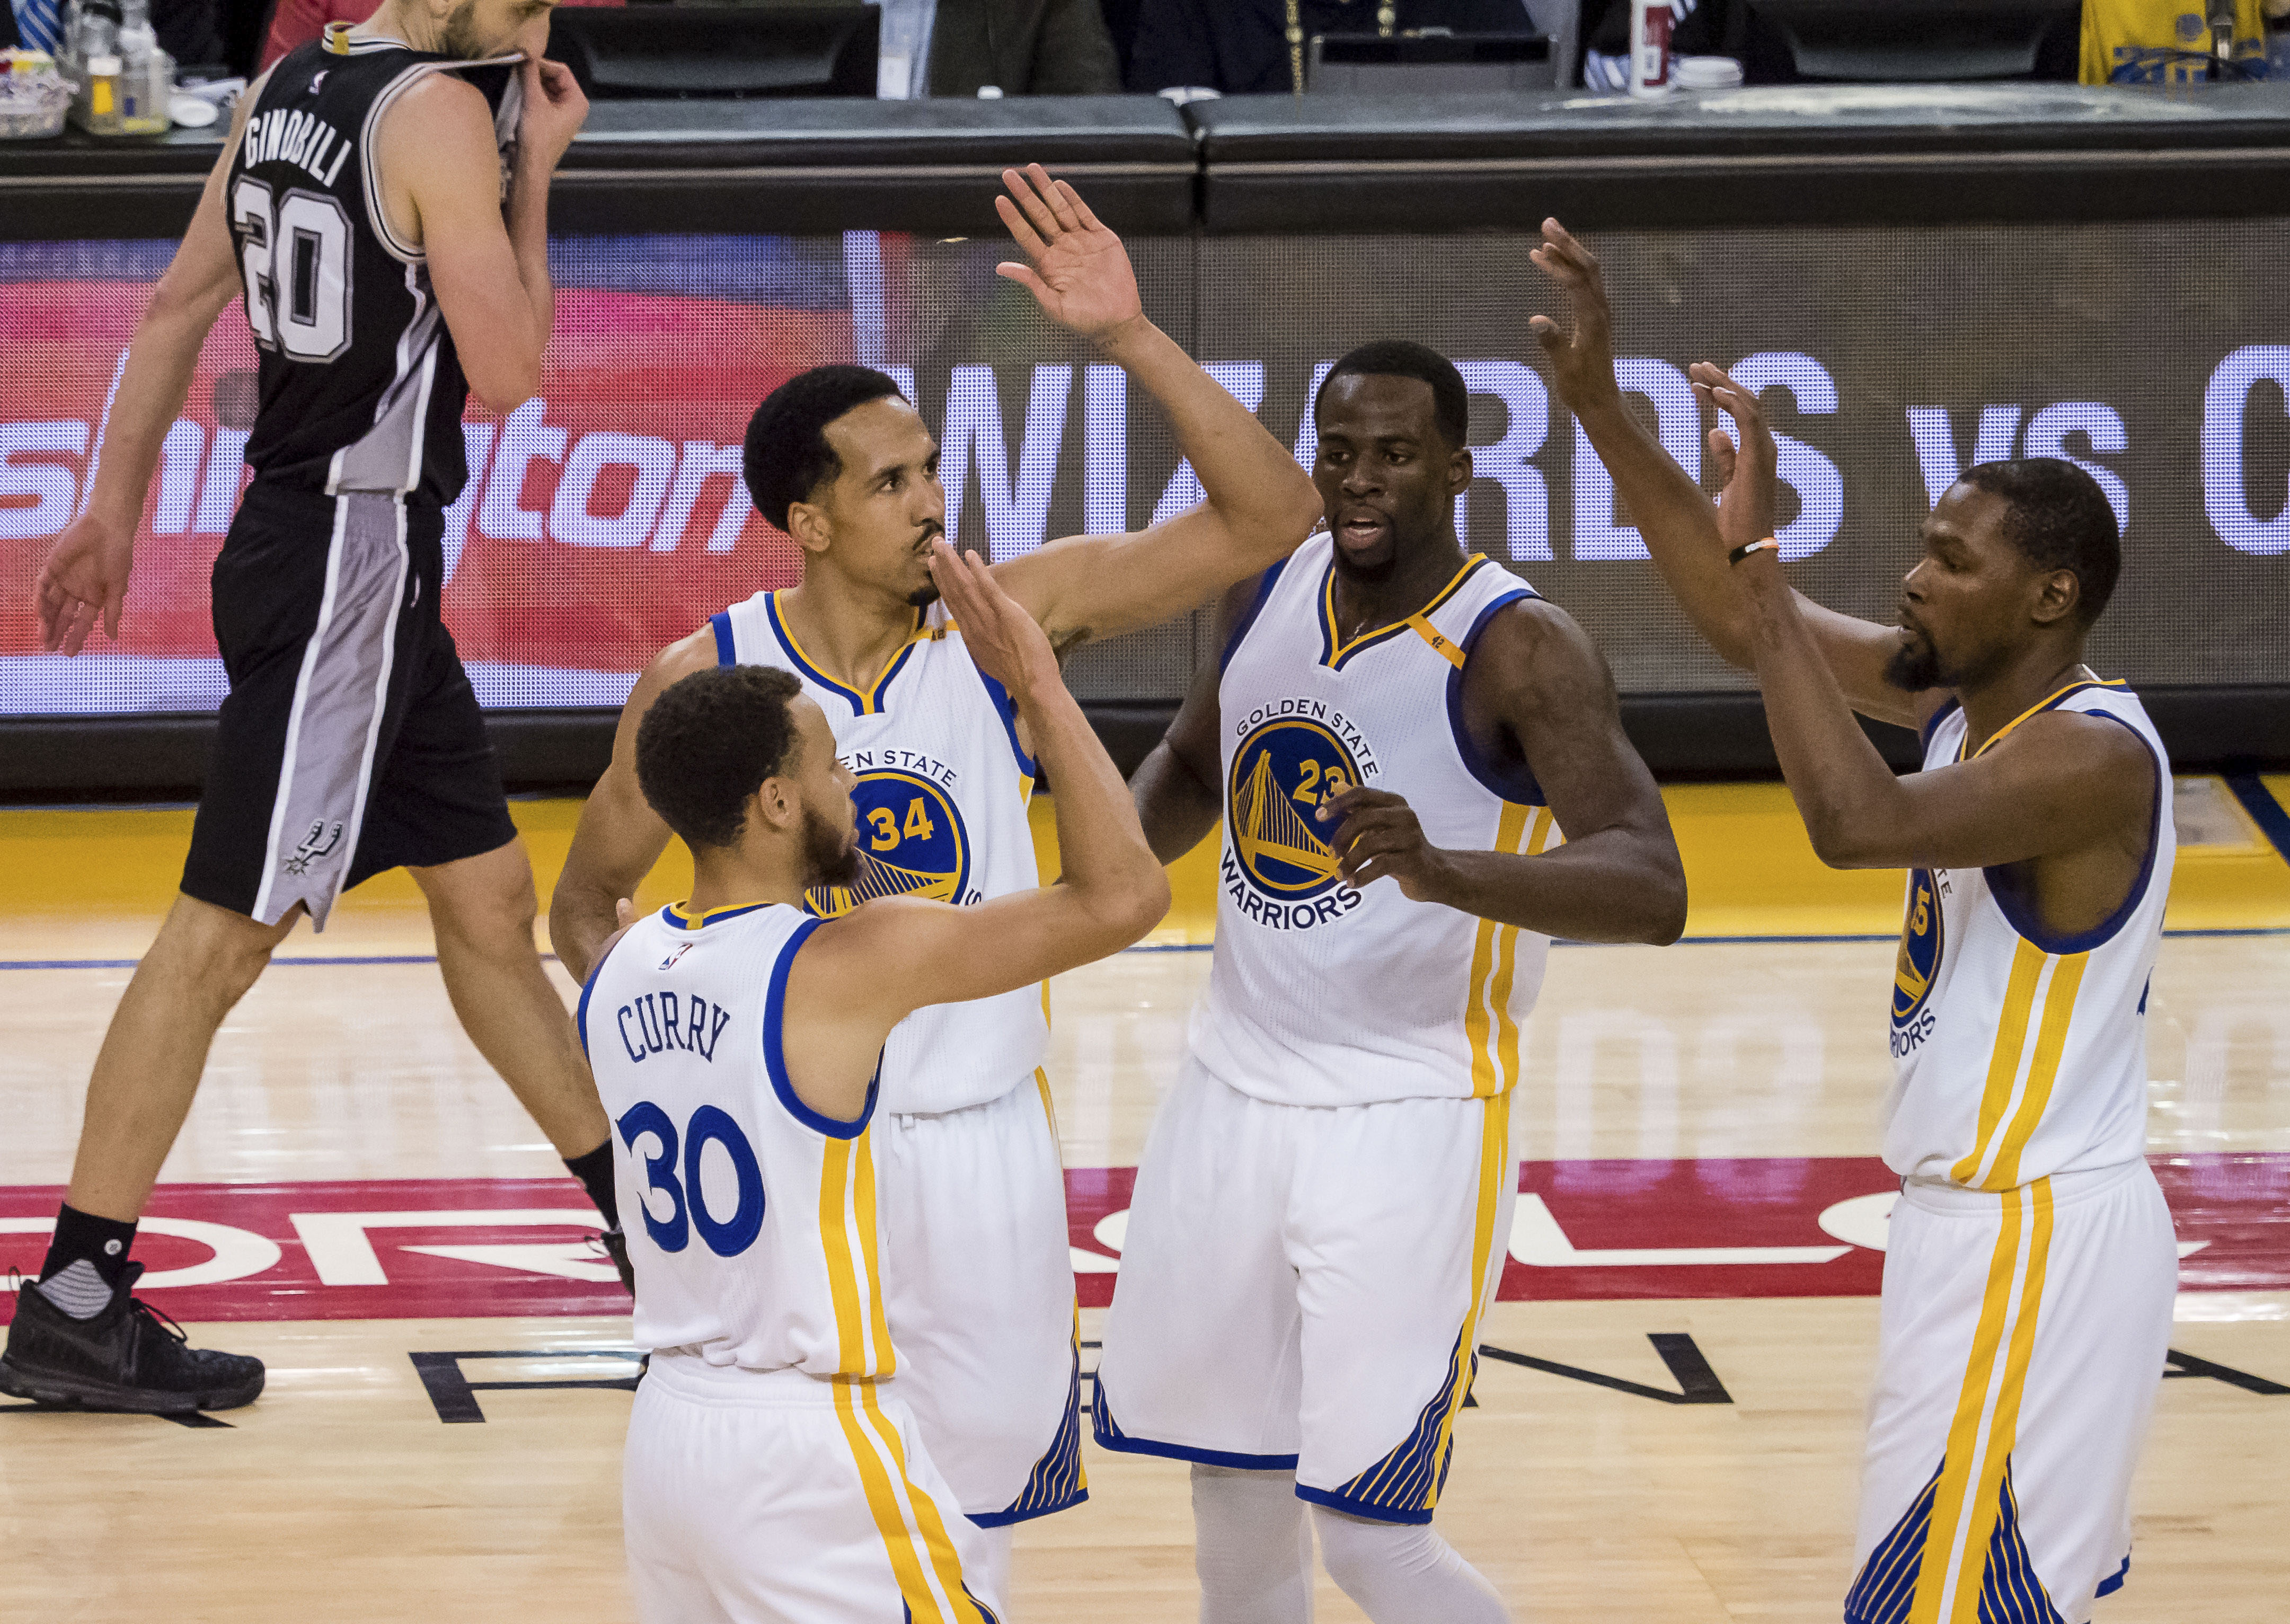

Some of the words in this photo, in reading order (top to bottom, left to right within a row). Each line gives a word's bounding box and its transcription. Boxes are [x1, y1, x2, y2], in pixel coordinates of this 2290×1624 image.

[244, 108, 352, 188] GINOBILI
[232, 173, 353, 364] 20
[872, 352, 1844, 563] WIRDS
[1431, 636, 1445, 649] 42
[883, 749, 958, 788] STATE
[1236, 699, 1327, 737] GOLDEN
[1331, 712, 1380, 779] STATE
[866, 797, 934, 852] 34
[1221, 845, 1363, 930] WARRIORS
[616, 991, 731, 1064] CURRY
[615, 1100, 766, 1257] 30
